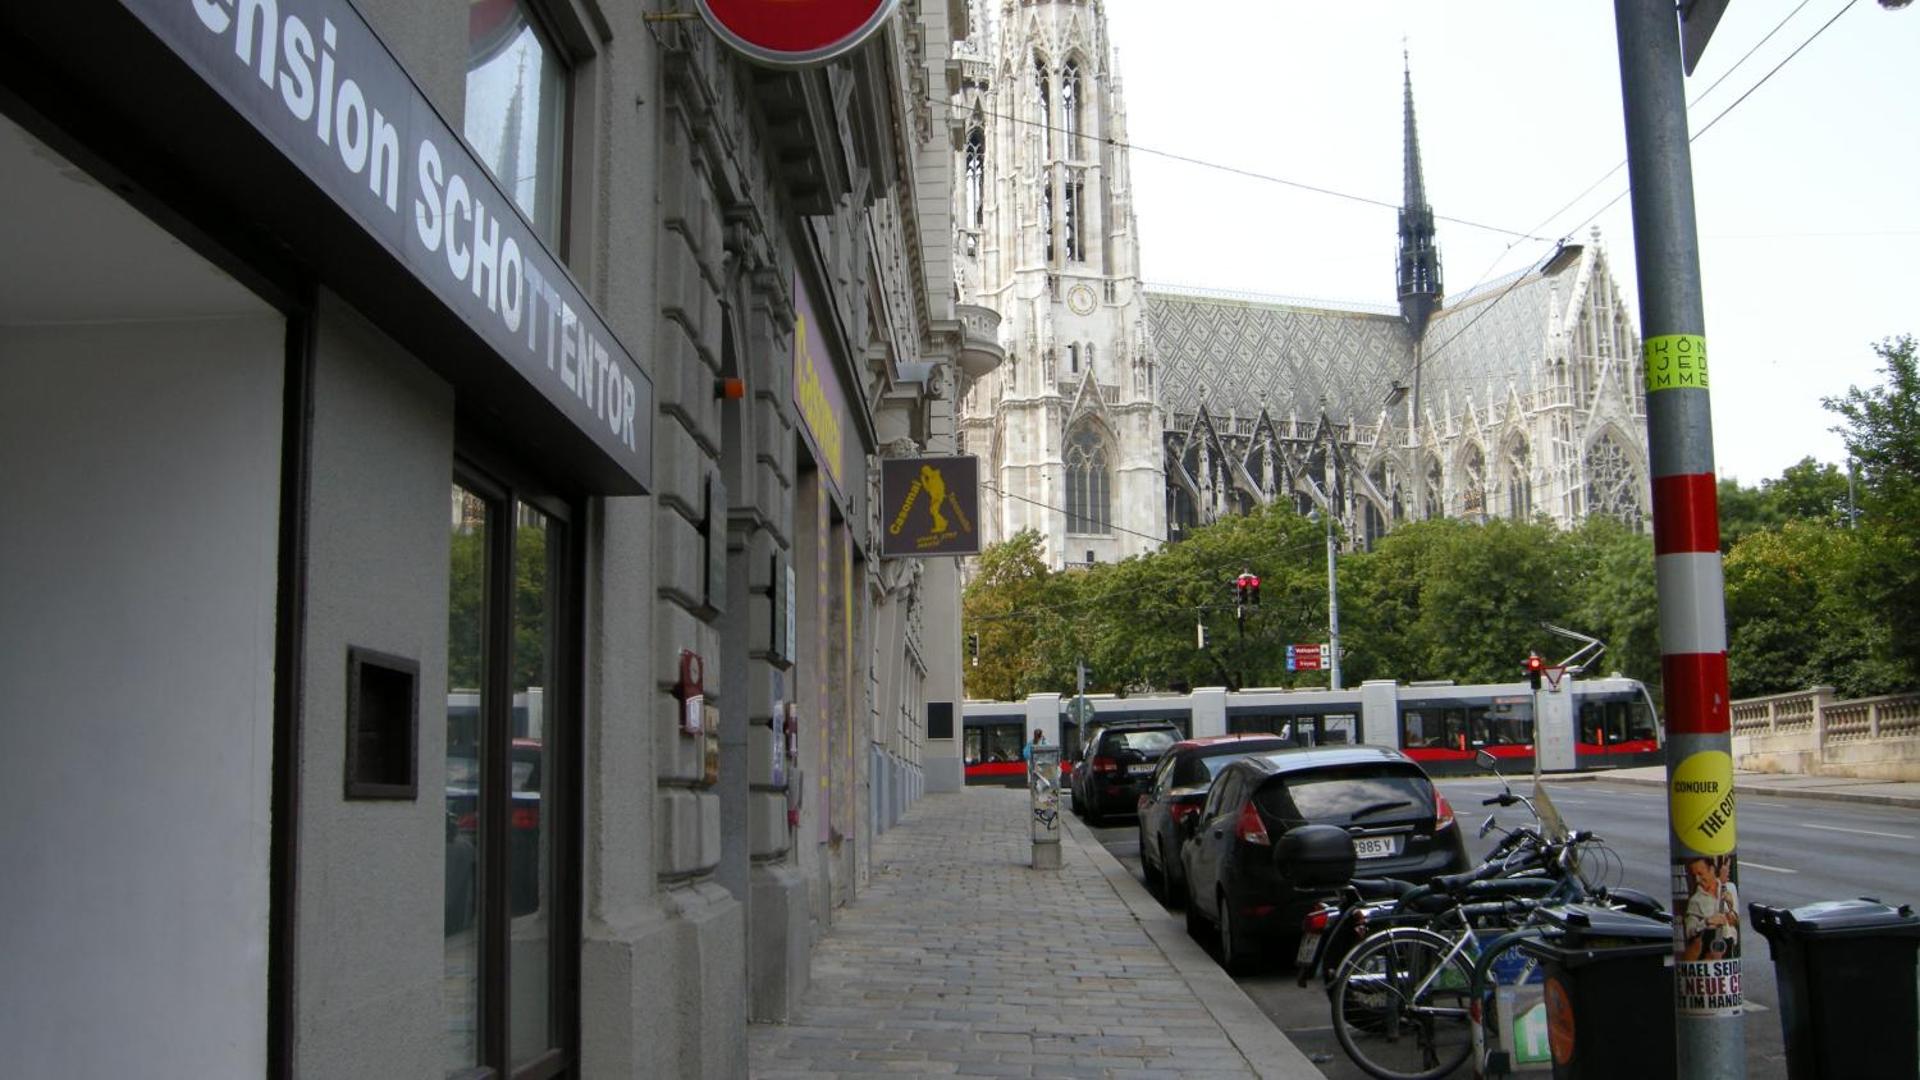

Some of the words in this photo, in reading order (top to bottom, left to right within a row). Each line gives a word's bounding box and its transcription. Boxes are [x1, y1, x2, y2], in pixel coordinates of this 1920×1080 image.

[415, 139, 635, 452] SCHOTTENTOR
[1674, 781, 1718, 793] CONQUER
[1697, 809, 1726, 838] THE
[1720, 786, 1735, 818] CIT
[1384, 839, 1391, 852] V
[1685, 977, 1726, 995] NEUE
